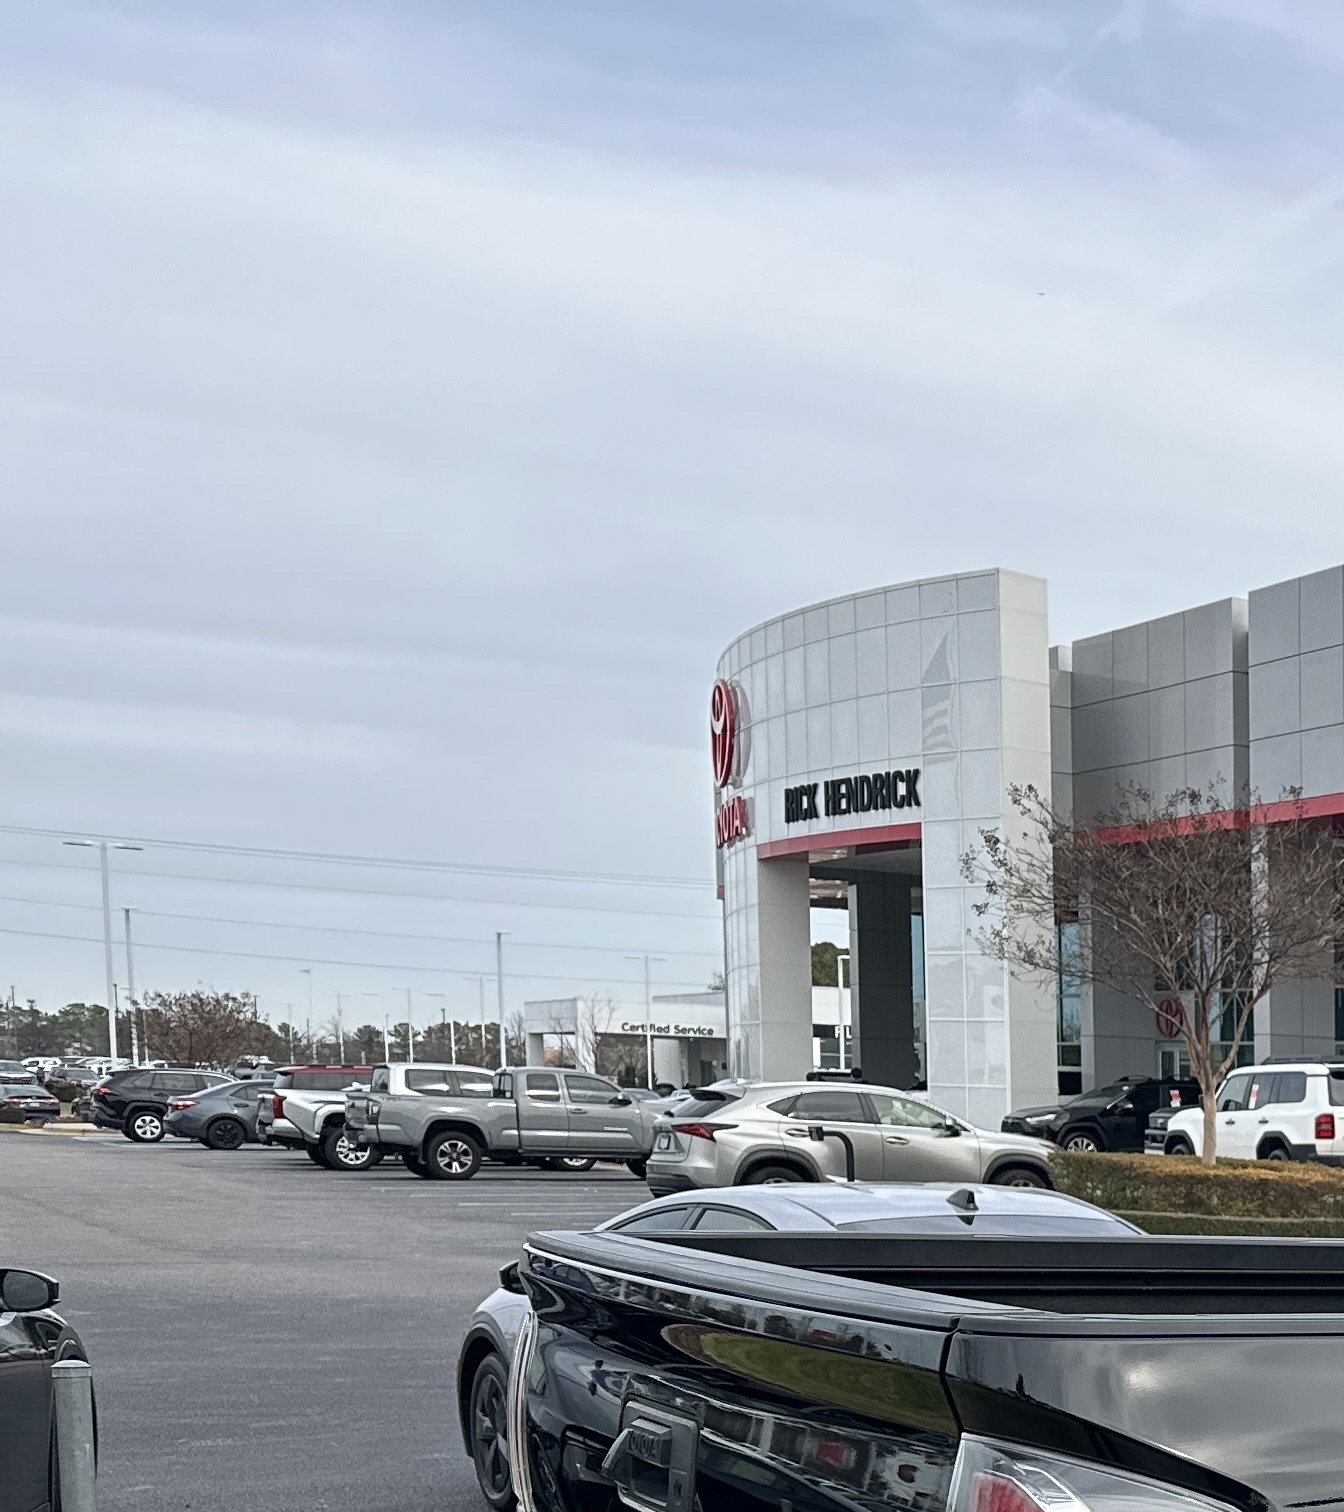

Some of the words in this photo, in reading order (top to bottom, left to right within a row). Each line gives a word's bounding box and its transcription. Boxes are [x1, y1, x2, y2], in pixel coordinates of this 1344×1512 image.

[784, 783, 819, 824] RICK
[824, 768, 922, 817] HENDRICK
[621, 1022, 670, 1034] Certified
[673, 1024, 714, 1036] Service
